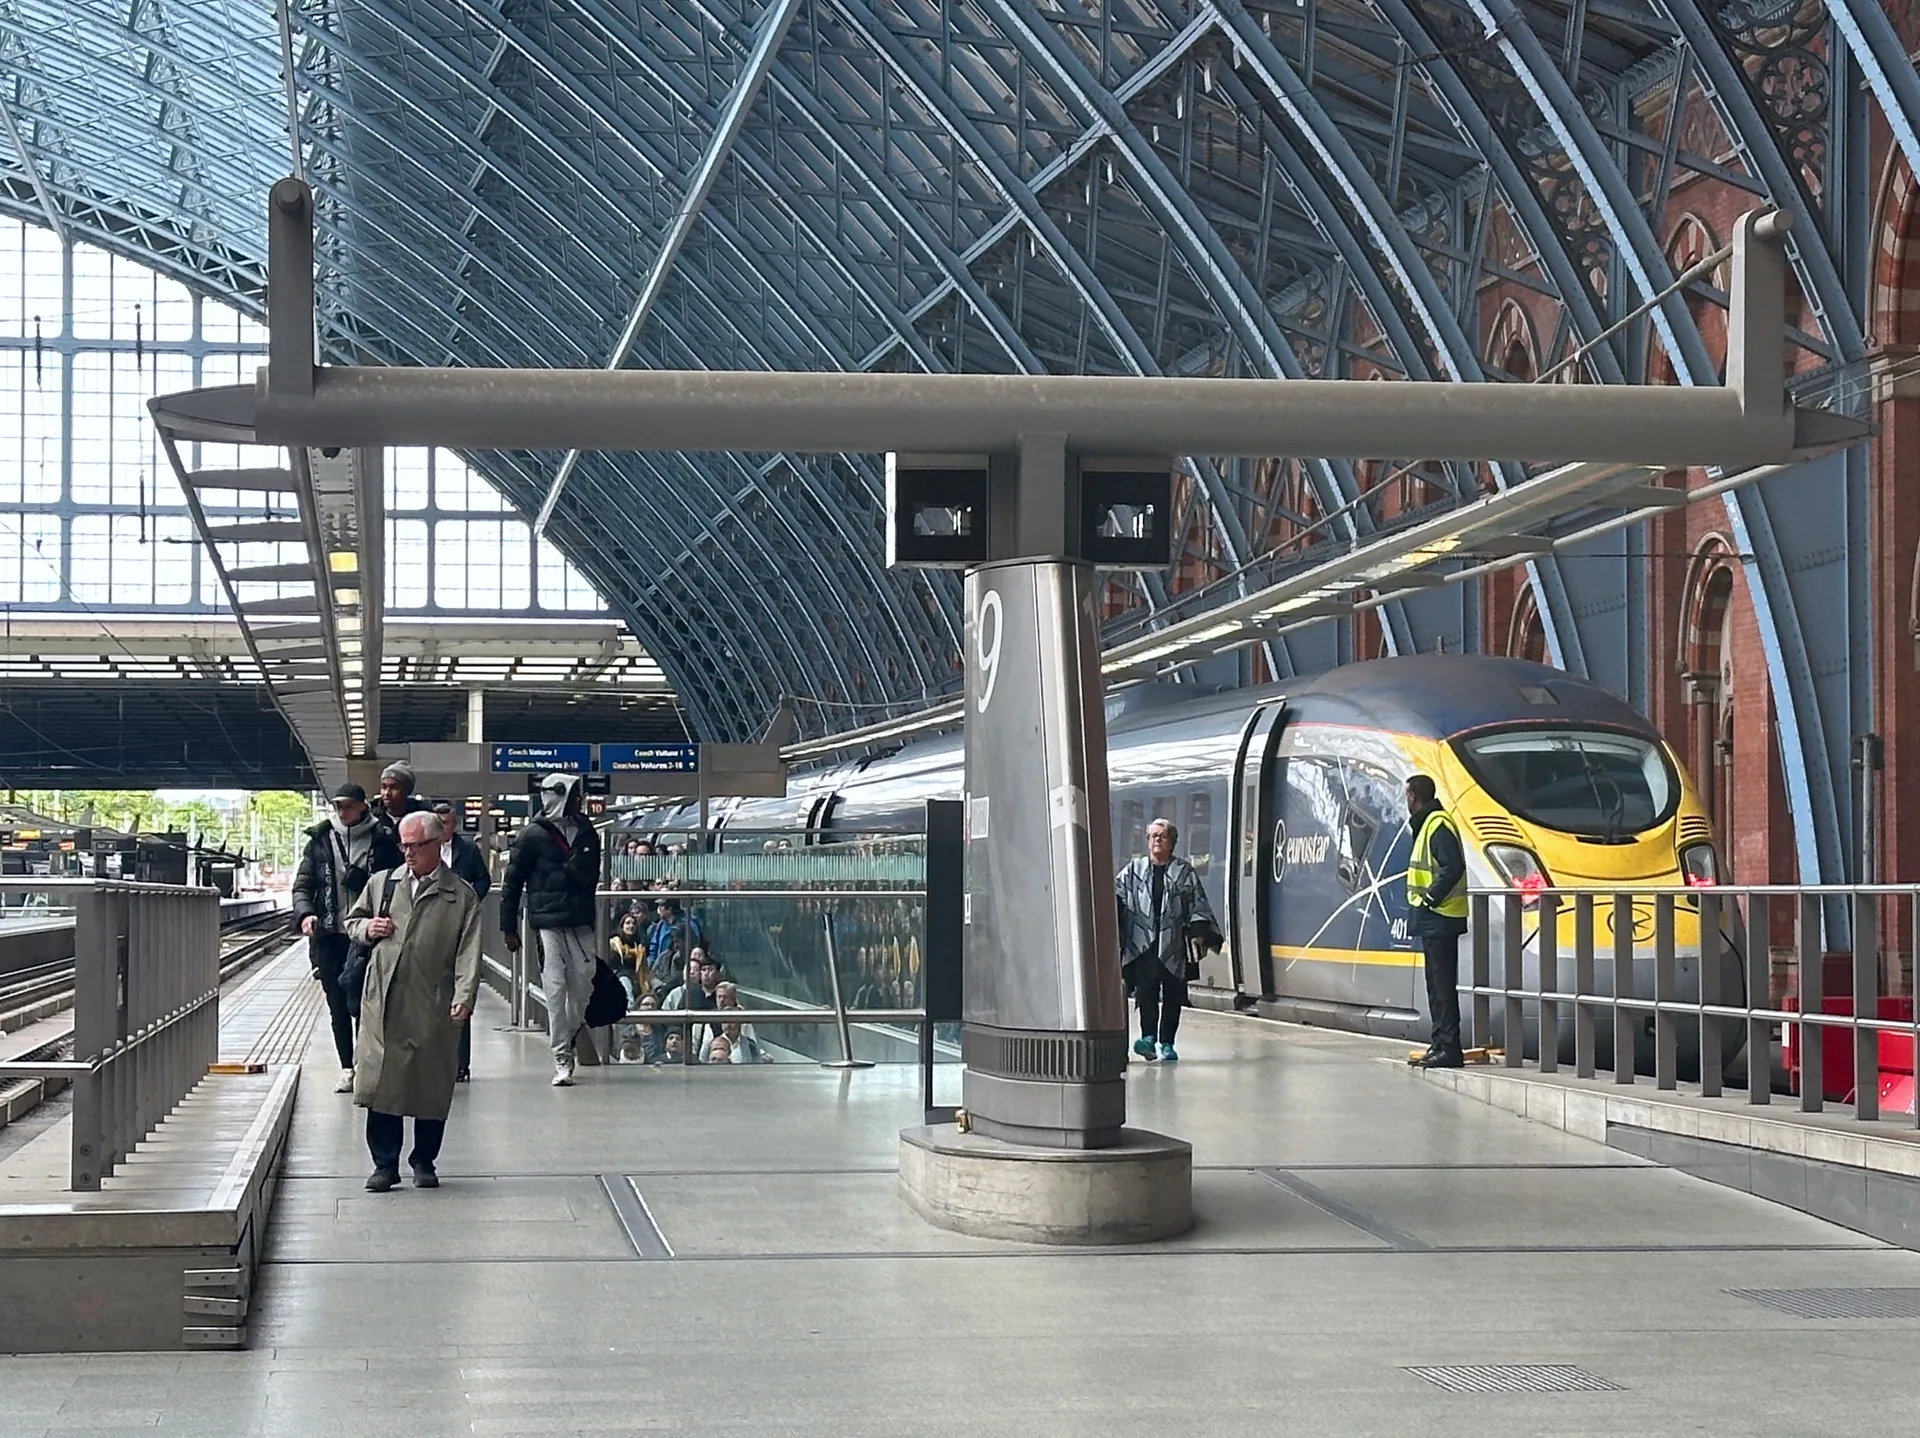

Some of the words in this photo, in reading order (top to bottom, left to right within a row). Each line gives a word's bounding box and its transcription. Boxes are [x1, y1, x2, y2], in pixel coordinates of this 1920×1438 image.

[977, 589, 1004, 714] 9
[591, 803, 603, 814] 10
[1286, 831, 1330, 864] eurostar
[1390, 917, 1413, 940] 401
